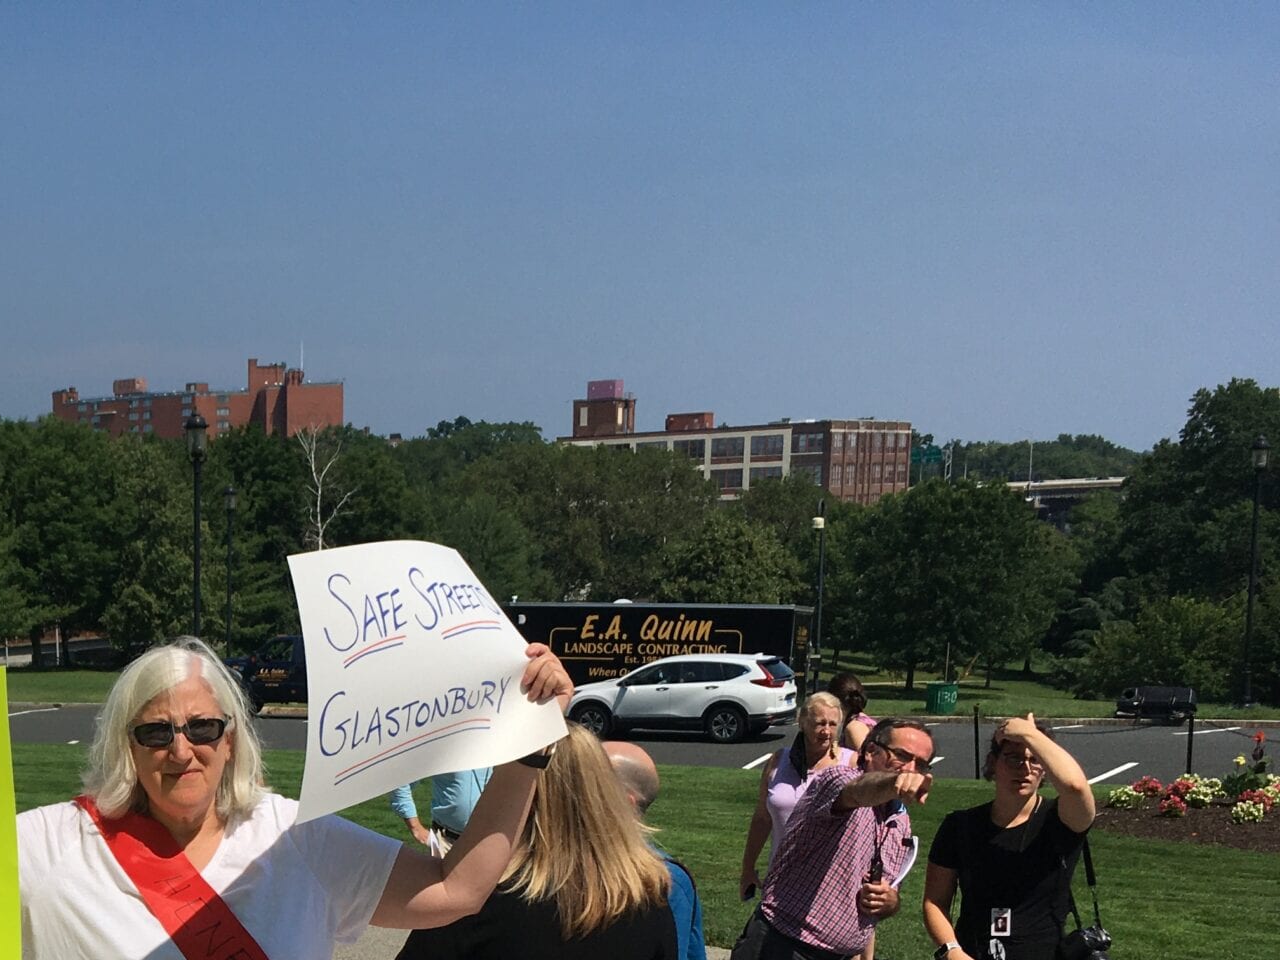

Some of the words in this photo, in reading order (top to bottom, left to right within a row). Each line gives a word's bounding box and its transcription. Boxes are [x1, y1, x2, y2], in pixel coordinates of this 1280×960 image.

[324, 573, 407, 652] SAFE
[580, 614, 628, 640] E.A.
[639, 613, 713, 642] Quinn
[564, 642, 633, 655] LANDSCAPE
[637, 643, 727, 656] CONTRACTING
[624, 655, 640, 664] Est.
[588, 667, 617, 677] When
[319, 676, 512, 757] GLASTONBURY
